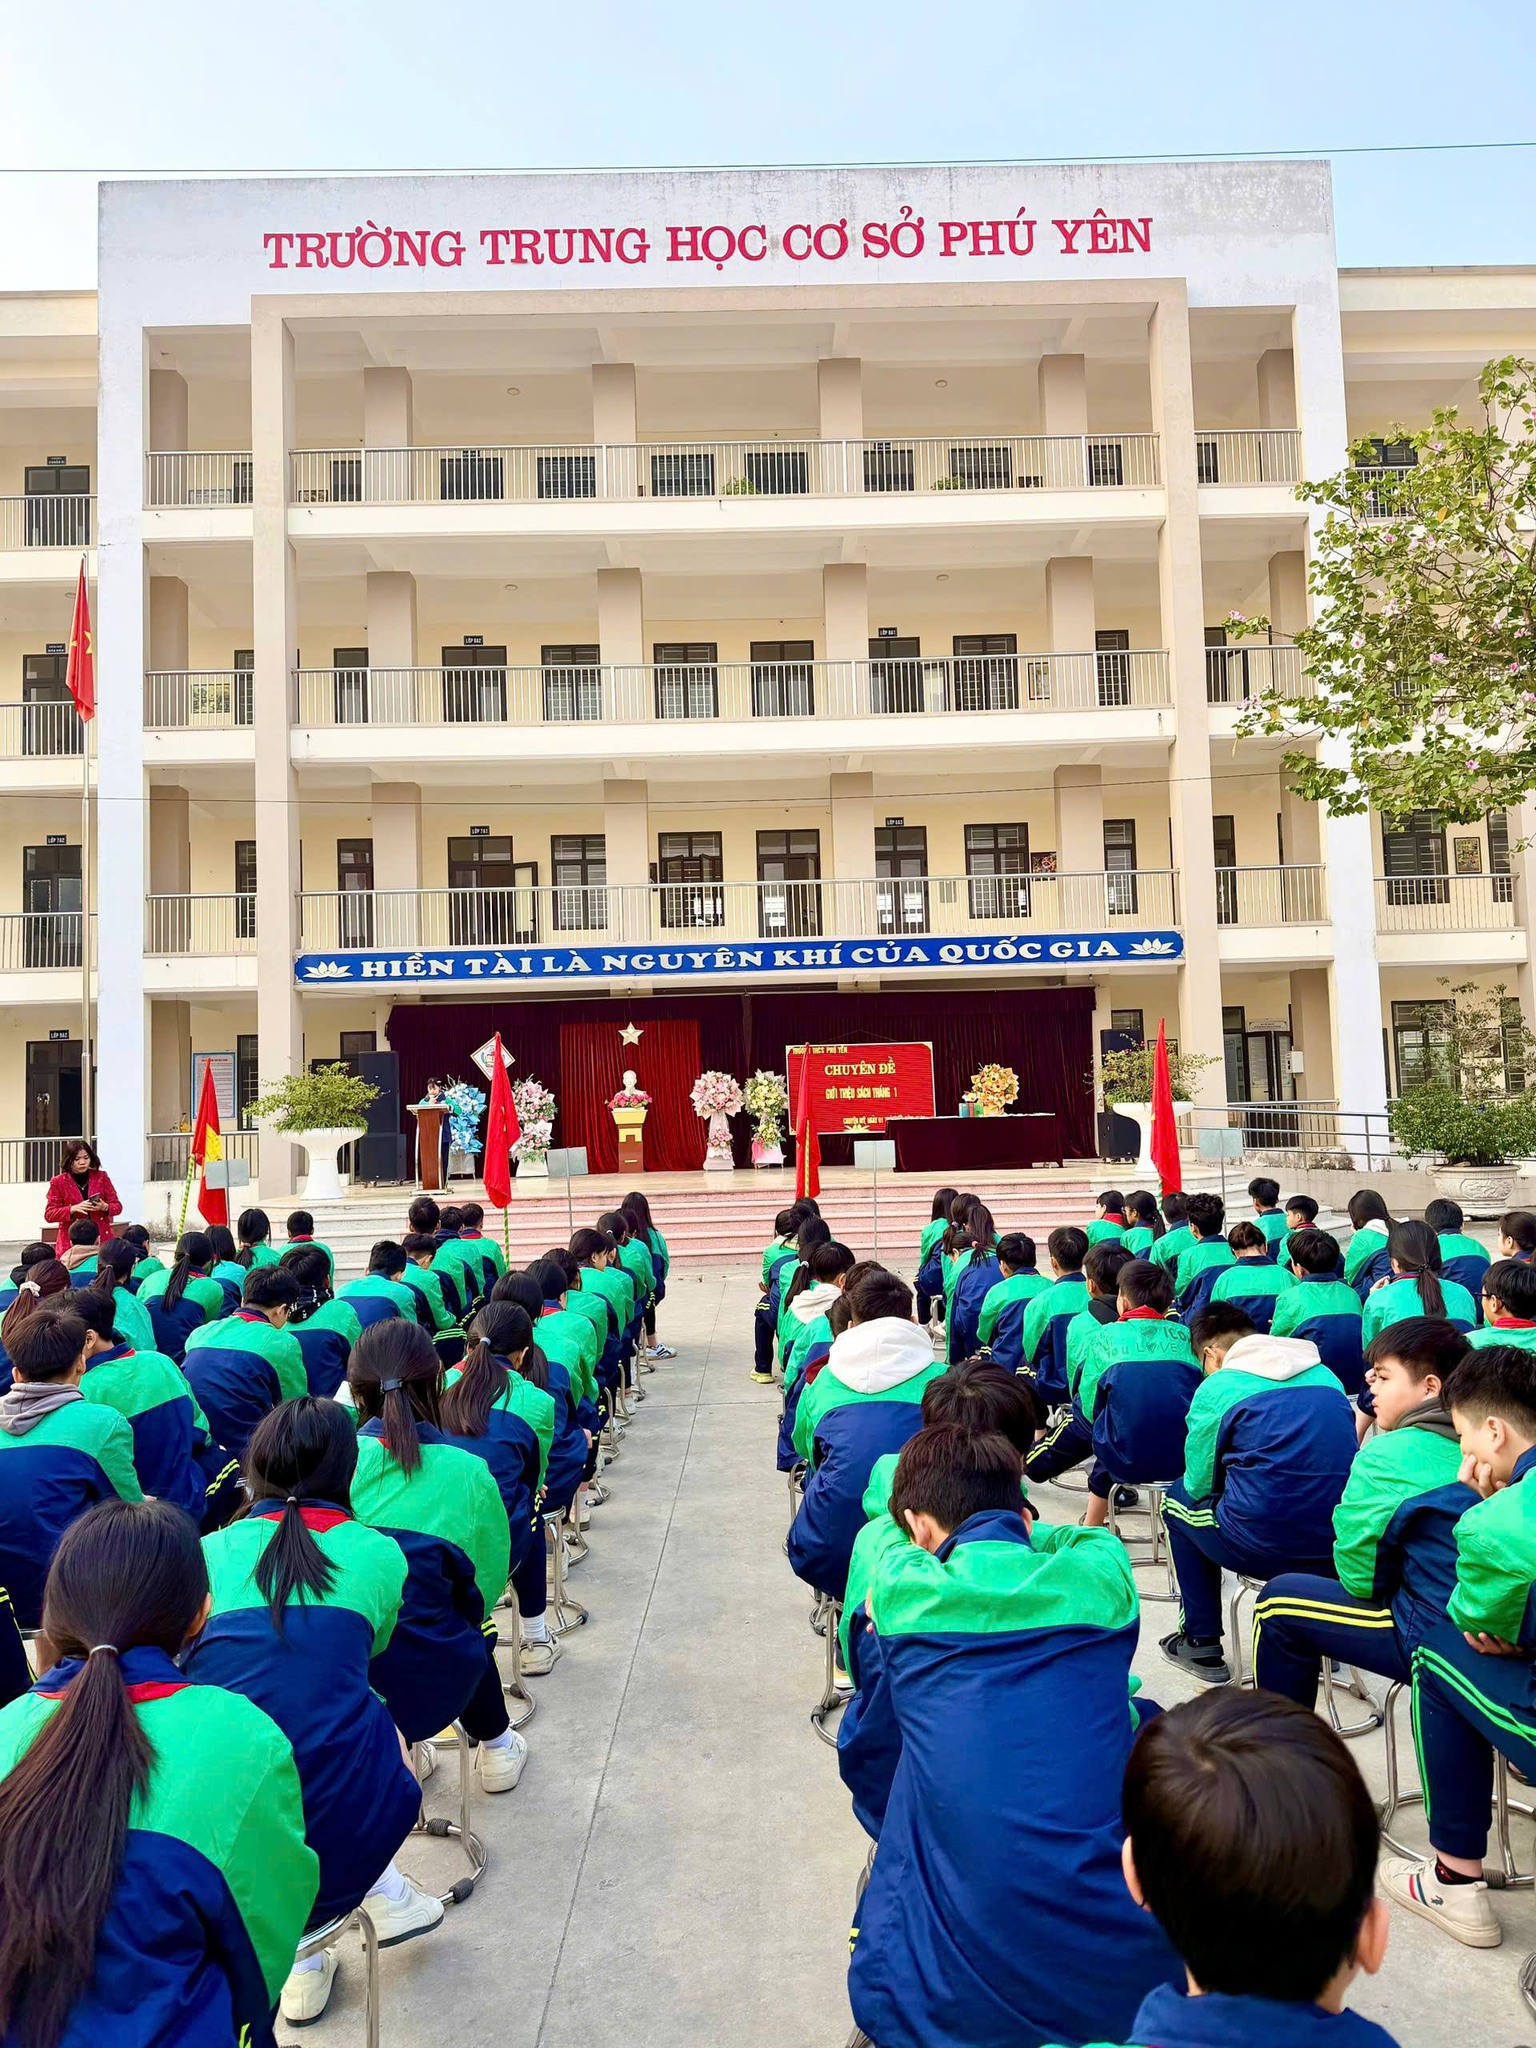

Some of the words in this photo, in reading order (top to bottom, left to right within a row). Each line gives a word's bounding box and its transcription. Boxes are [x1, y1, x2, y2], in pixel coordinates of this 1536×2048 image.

[263, 220, 466, 269] TRƯỜNG
[480, 228, 651, 266] TRUNG
[666, 225, 768, 271] HỌC
[782, 218, 848, 260] CƠ
[863, 205, 925, 259] SỞ
[938, 206, 1037, 257] PHÚ
[1052, 207, 1154, 255] YÊN
[360, 951, 455, 978] HIỀN
[464, 951, 531, 976] TÀI
[542, 949, 592, 974] LÀ
[602, 946, 764, 971] NGUYÊN
[773, 941, 841, 966] KHÍ
[850, 941, 931, 964] CỦA
[938, 936, 1042, 963] QUỐC
[1049, 940, 1120, 959] GIA
[825, 1061, 876, 1075] CHUYÊN
[879, 1056, 896, 1074] ĐỀ
[857, 1086, 871, 1098] SÁCH
